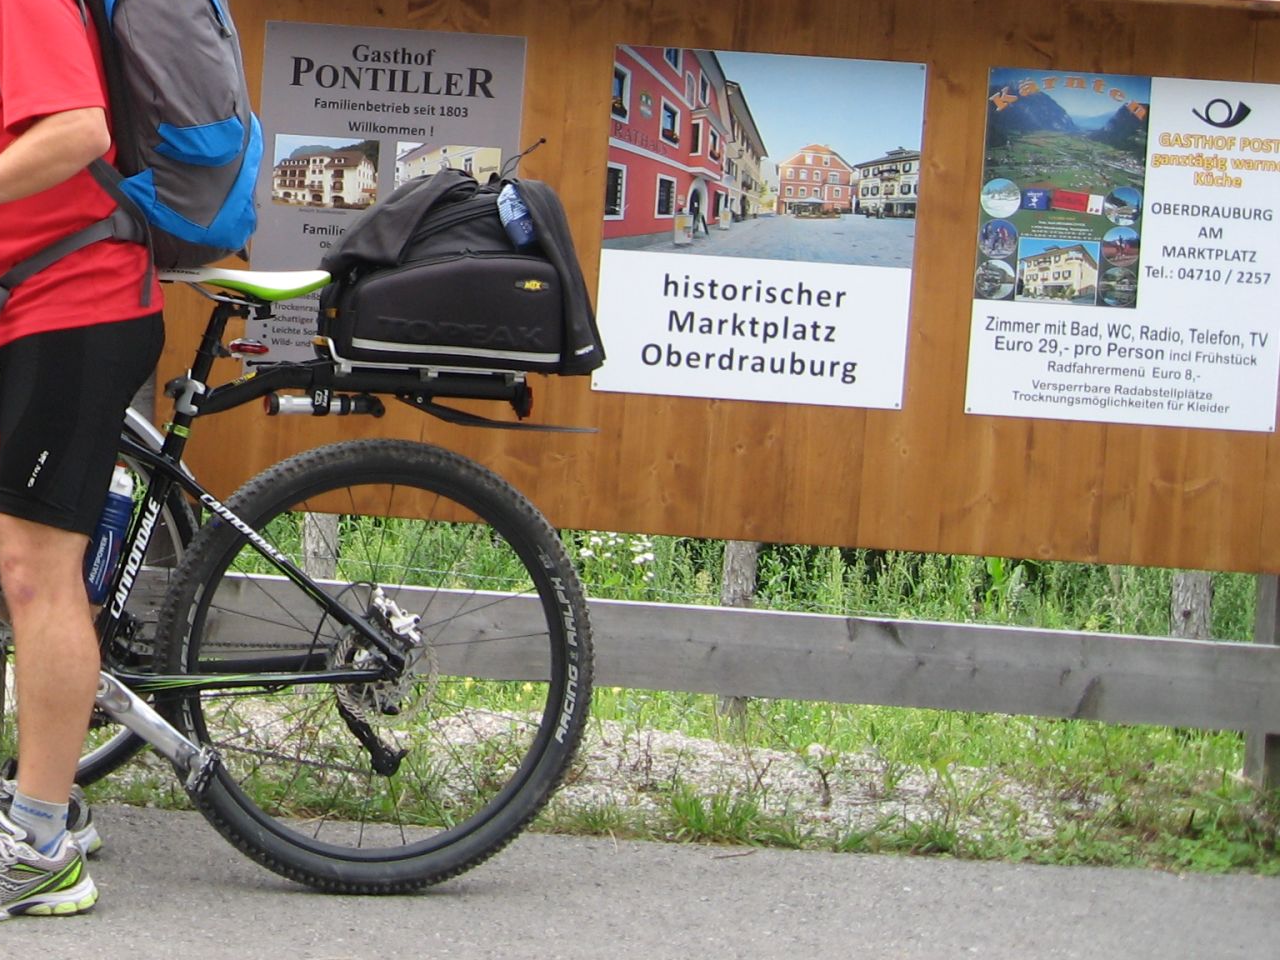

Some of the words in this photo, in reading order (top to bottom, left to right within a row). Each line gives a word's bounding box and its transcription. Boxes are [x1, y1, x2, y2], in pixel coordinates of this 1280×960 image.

[352, 43, 436, 67] Gasthof
[289, 55, 496, 99] PONTILLER
[314, 97, 410, 116] Familienbetrieb
[414, 102, 437, 117] seit
[439, 105, 469, 119] 1803
[989, 76, 1148, 122] Kärnten
[348, 120, 426, 137] Willkommen
[1159, 132, 1237, 151] GASTHOF
[1240, 138, 1280, 154] POST
[1151, 153, 1227, 171] ganztägig
[1193, 171, 1243, 188] Küche
[1151, 202, 1273, 222] OBERDRAUBURG
[1198, 227, 1223, 239] AM
[1162, 245, 1257, 263] MARKTPLATZ
[1177, 267, 1221, 282] 04710
[1236, 271, 1271, 285] 2257
[663, 273, 847, 308] historischer
[668, 310, 837, 343] Marktplatz
[985, 316, 1041, 334] Zimmer
[1044, 320, 1067, 336] mit
[1070, 321, 1102, 340] Bad,
[1107, 324, 1135, 342] WC,
[1139, 325, 1185, 345] Radio,
[1189, 328, 1245, 349] Telefon,
[1249, 332, 1269, 348] TV
[994, 336, 1034, 353] Euro
[1073, 344, 1102, 360] pro
[1107, 342, 1165, 360] Person
[1169, 350, 1192, 362] incl
[1195, 352, 1258, 367] Frühstück
[641, 343, 858, 385] Oberdrauburg
[1047, 361, 1146, 378] Radfahrermenü
[1152, 367, 1182, 380] Euro
[1032, 379, 1111, 395] Versperrbare
[1114, 385, 1213, 401] Radabstellplätze
[1012, 391, 1164, 410] Trocknungsmöglichkeiten
[1167, 399, 1183, 412] für
[1187, 402, 1230, 414] Kleider
[201, 493, 286, 563] CANNONDALE
[111, 497, 160, 619] CANNONDALE
[550, 577, 577, 646] RALPH
[555, 664, 579, 744] RACING
